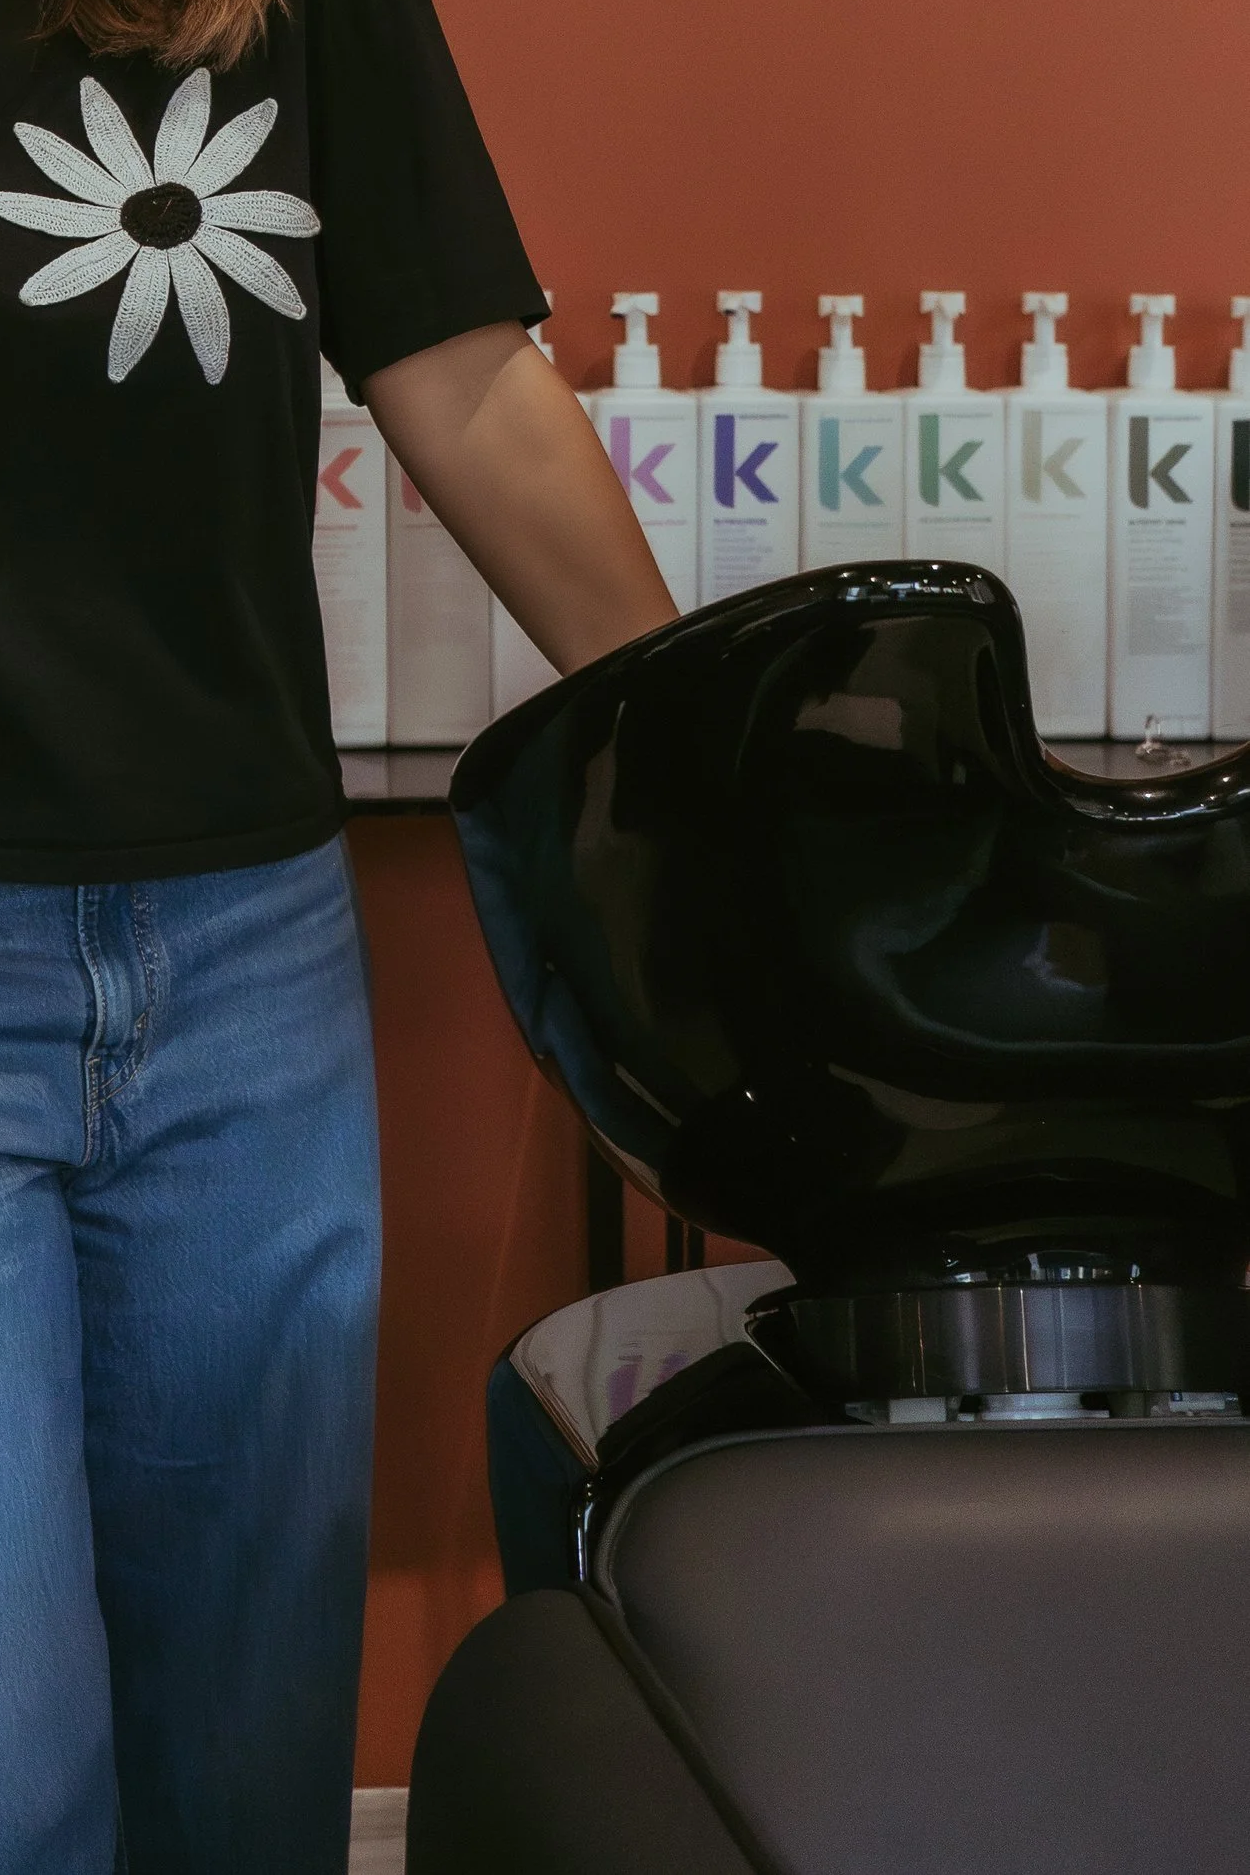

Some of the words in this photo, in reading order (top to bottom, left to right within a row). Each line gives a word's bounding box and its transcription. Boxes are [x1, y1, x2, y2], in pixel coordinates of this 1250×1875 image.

[610, 414, 676, 505] k
[713, 413, 780, 510] k
[817, 415, 886, 513] k
[917, 412, 985, 508] k
[1020, 408, 1088, 505] k
[1128, 415, 1195, 511] k
